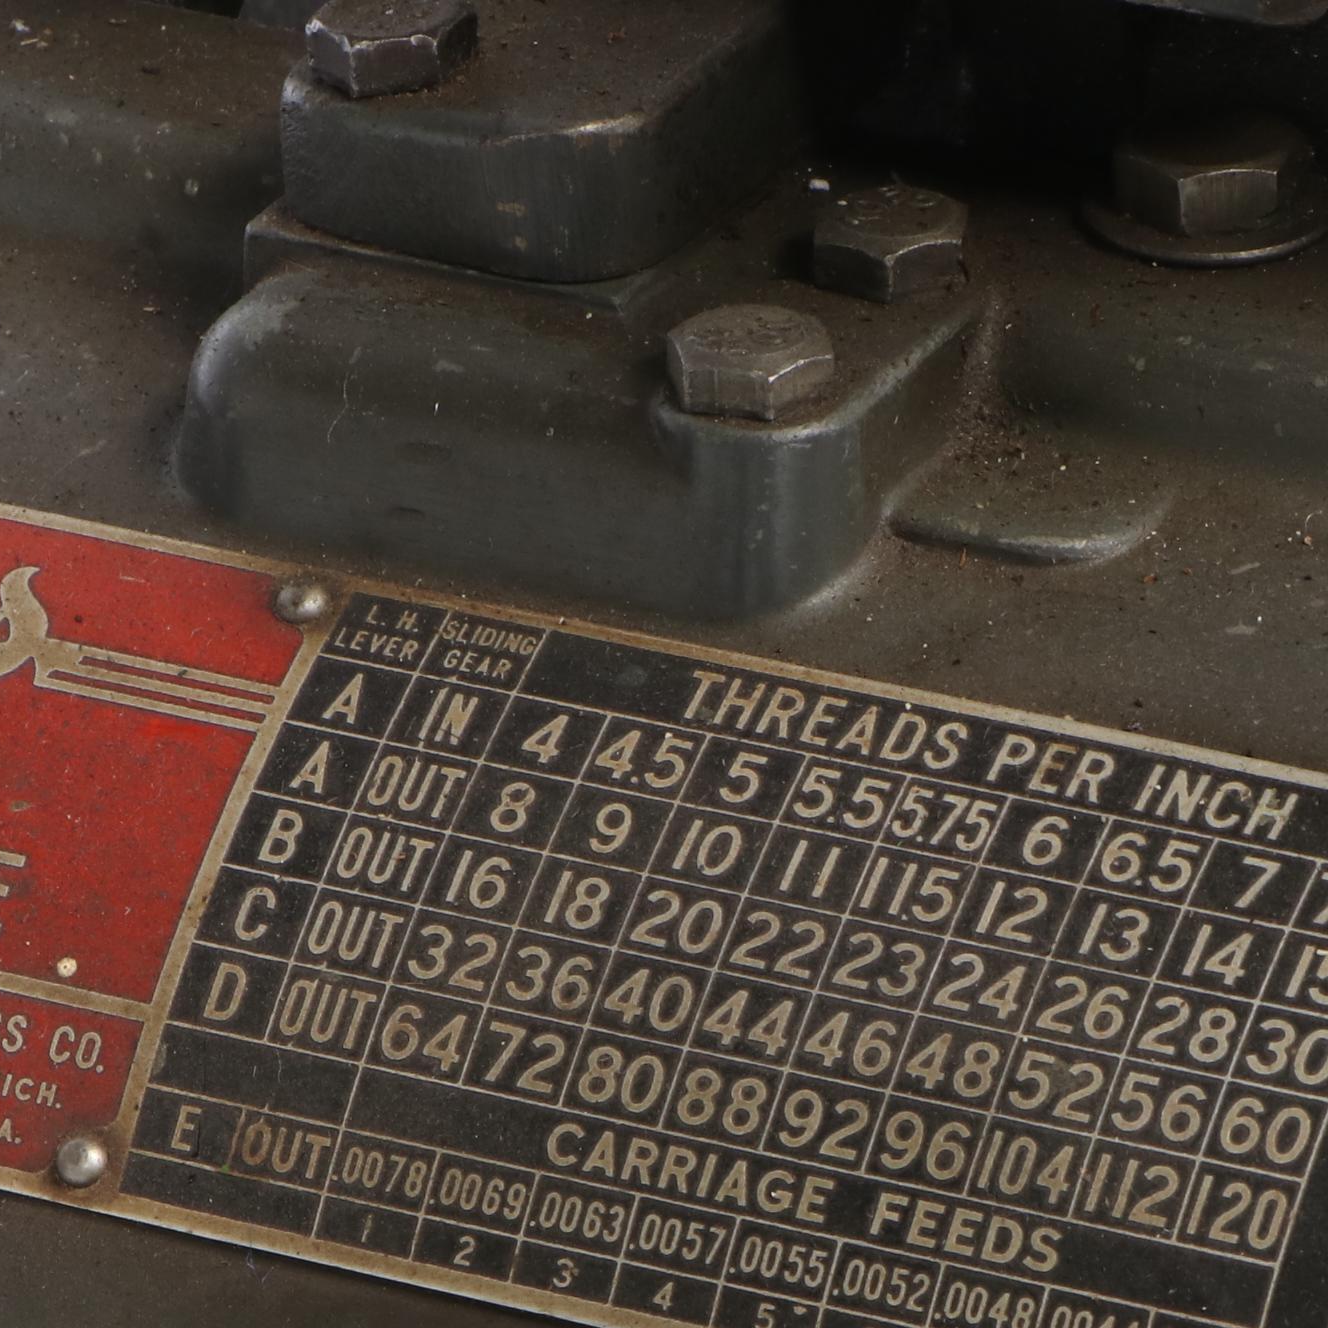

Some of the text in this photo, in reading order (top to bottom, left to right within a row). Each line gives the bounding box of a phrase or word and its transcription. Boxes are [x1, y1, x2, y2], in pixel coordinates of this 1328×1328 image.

[333, 628, 420, 662] LEVER
[440, 620, 540, 655] SLIDING
[443, 650, 513, 680] GEAR
[322, 674, 364, 724] A
[422, 686, 480, 745] IN
[522, 715, 561, 763] 4
[593, 730, 694, 789] 4.5
[719, 754, 768, 803] 5
[792, 769, 896, 829] 5.5
[889, 786, 998, 851] 5.75
[1021, 816, 1070, 866] 6
[1100, 834, 1201, 892] 6.5
[1233, 858, 1280, 908] 7
[681, 671, 1300, 841] THREADS PER INCH
[259, 811, 304, 864] B
[334, 826, 436, 891] OUT
[446, 851, 511, 909] 16
[542, 870, 611, 929] 18
[630, 890, 724, 954] 20
[730, 912, 830, 979] 22
[832, 932, 927, 996] 23
[932, 954, 1027, 1020] 24
[1034, 976, 1127, 1039] 26
[1136, 998, 1237, 1062] 28
[290, 741, 331, 794] A
[366, 756, 467, 819] OUT
[490, 782, 536, 832] 8
[590, 804, 633, 854] 9
[672, 821, 743, 876] 10
[780, 840, 842, 898] 11
[858, 858, 958, 922] 11.5
[977, 882, 1048, 943] 12
[1080, 904, 1151, 962] 13
[1181, 925, 1254, 985] 14
[48, 1032, 106, 1073] CO.
[203, 962, 1290, 1250] D OUT 64 72 80 88 92 96 104 112 120
[233, 888, 1312, 1164] C OUT 32 36 40 44 46 48 52 56 60
[171, 1106, 203, 1151] E
[240, 1117, 332, 1180] OUT
[332, 1143, 424, 1195] .0078
[430, 1166, 527, 1220] .0069
[530, 1189, 623, 1243] .0063
[630, 1211, 728, 1266] .0057
[728, 1235, 826, 1288] .0055
[833, 1262, 932, 1310] .0052
[361, 1215, 372, 1242] 1
[453, 1236, 475, 1267] 2
[553, 1259, 574, 1288] 3
[652, 1282, 674, 1311] 4
[547, 1122, 1066, 1272] CARRIAGE FEEDS
